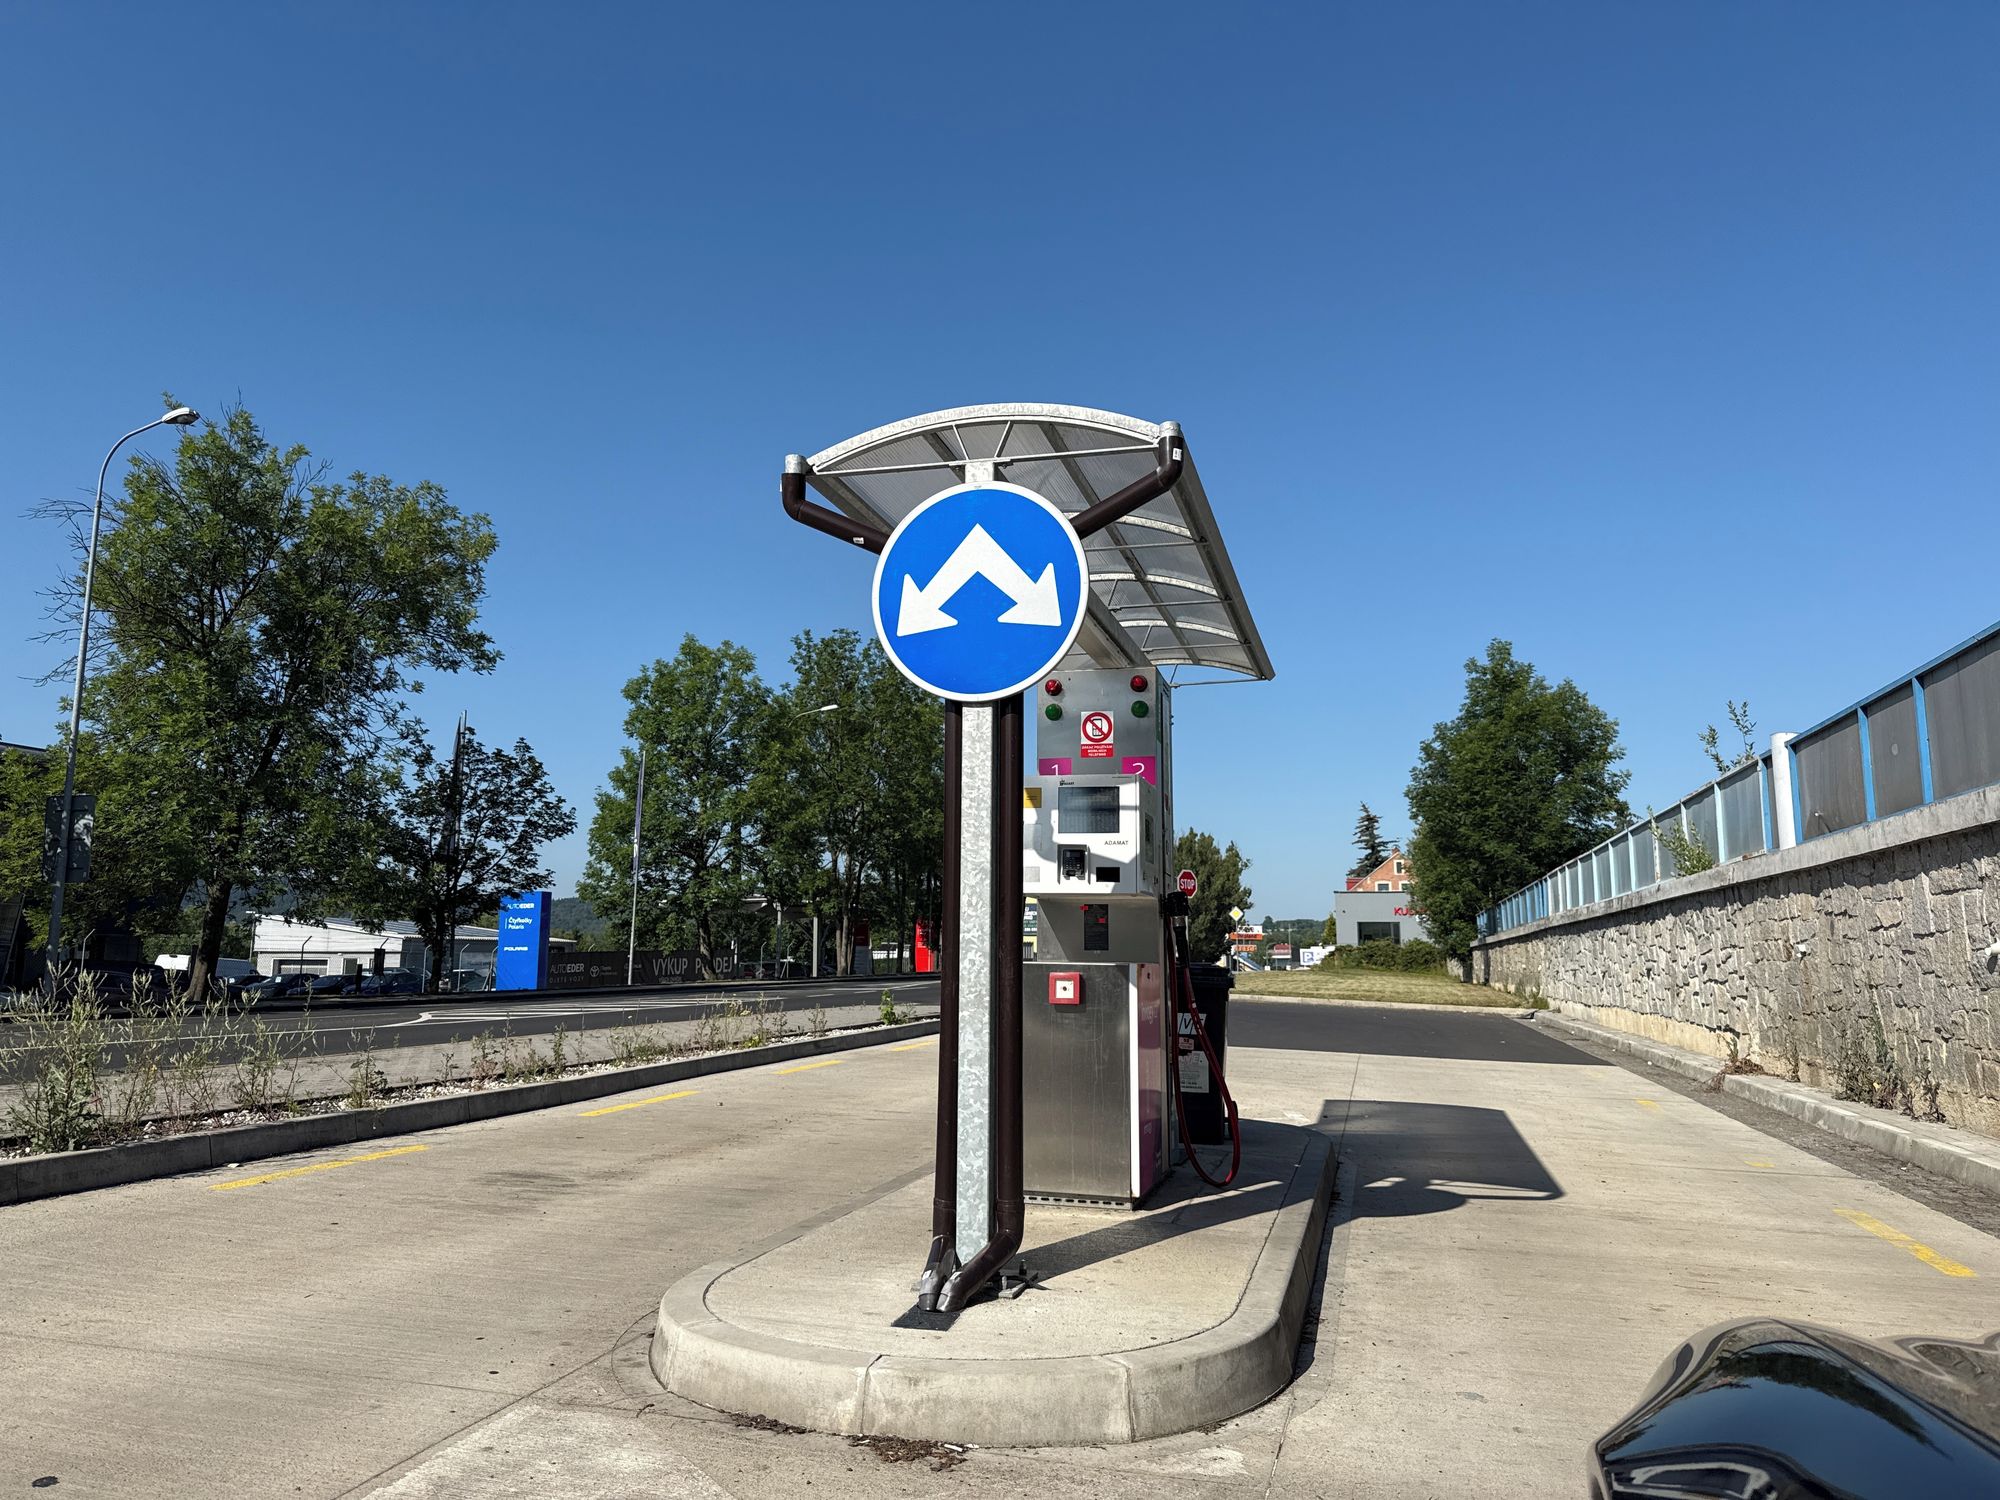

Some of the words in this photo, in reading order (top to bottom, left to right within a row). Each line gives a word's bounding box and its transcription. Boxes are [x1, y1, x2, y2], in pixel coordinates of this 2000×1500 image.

[1051, 764, 1059, 775] 1
[1132, 762, 1145, 779] 2
[1180, 878, 1195, 890] STOP
[652, 957, 689, 976] VYKUP
[695, 956, 733, 975] PDEJ
